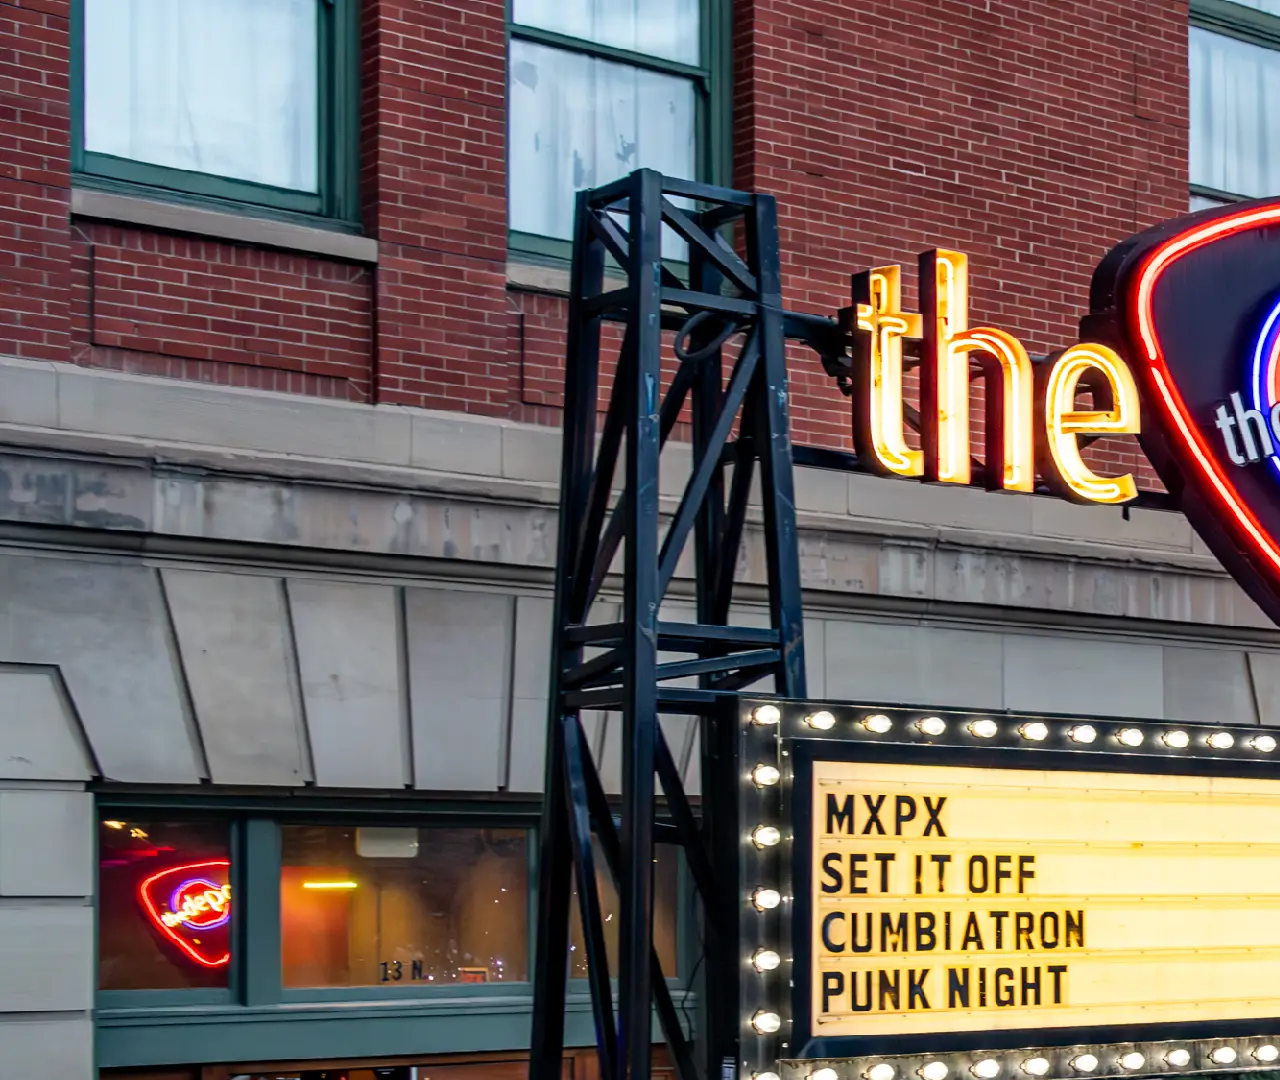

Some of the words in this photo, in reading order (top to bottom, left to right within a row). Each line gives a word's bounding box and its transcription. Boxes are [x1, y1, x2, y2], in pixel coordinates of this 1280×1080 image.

[853, 248, 1142, 505] the
[824, 793, 947, 836] MXPX
[820, 852, 896, 893] SET
[914, 854, 951, 891] IT
[967, 854, 1036, 892] OFF
[820, 909, 1084, 952] CUMBIATRON
[380, 961, 403, 982] 13
[820, 968, 931, 1012] PUNK
[947, 964, 1067, 1007] NIGHT
